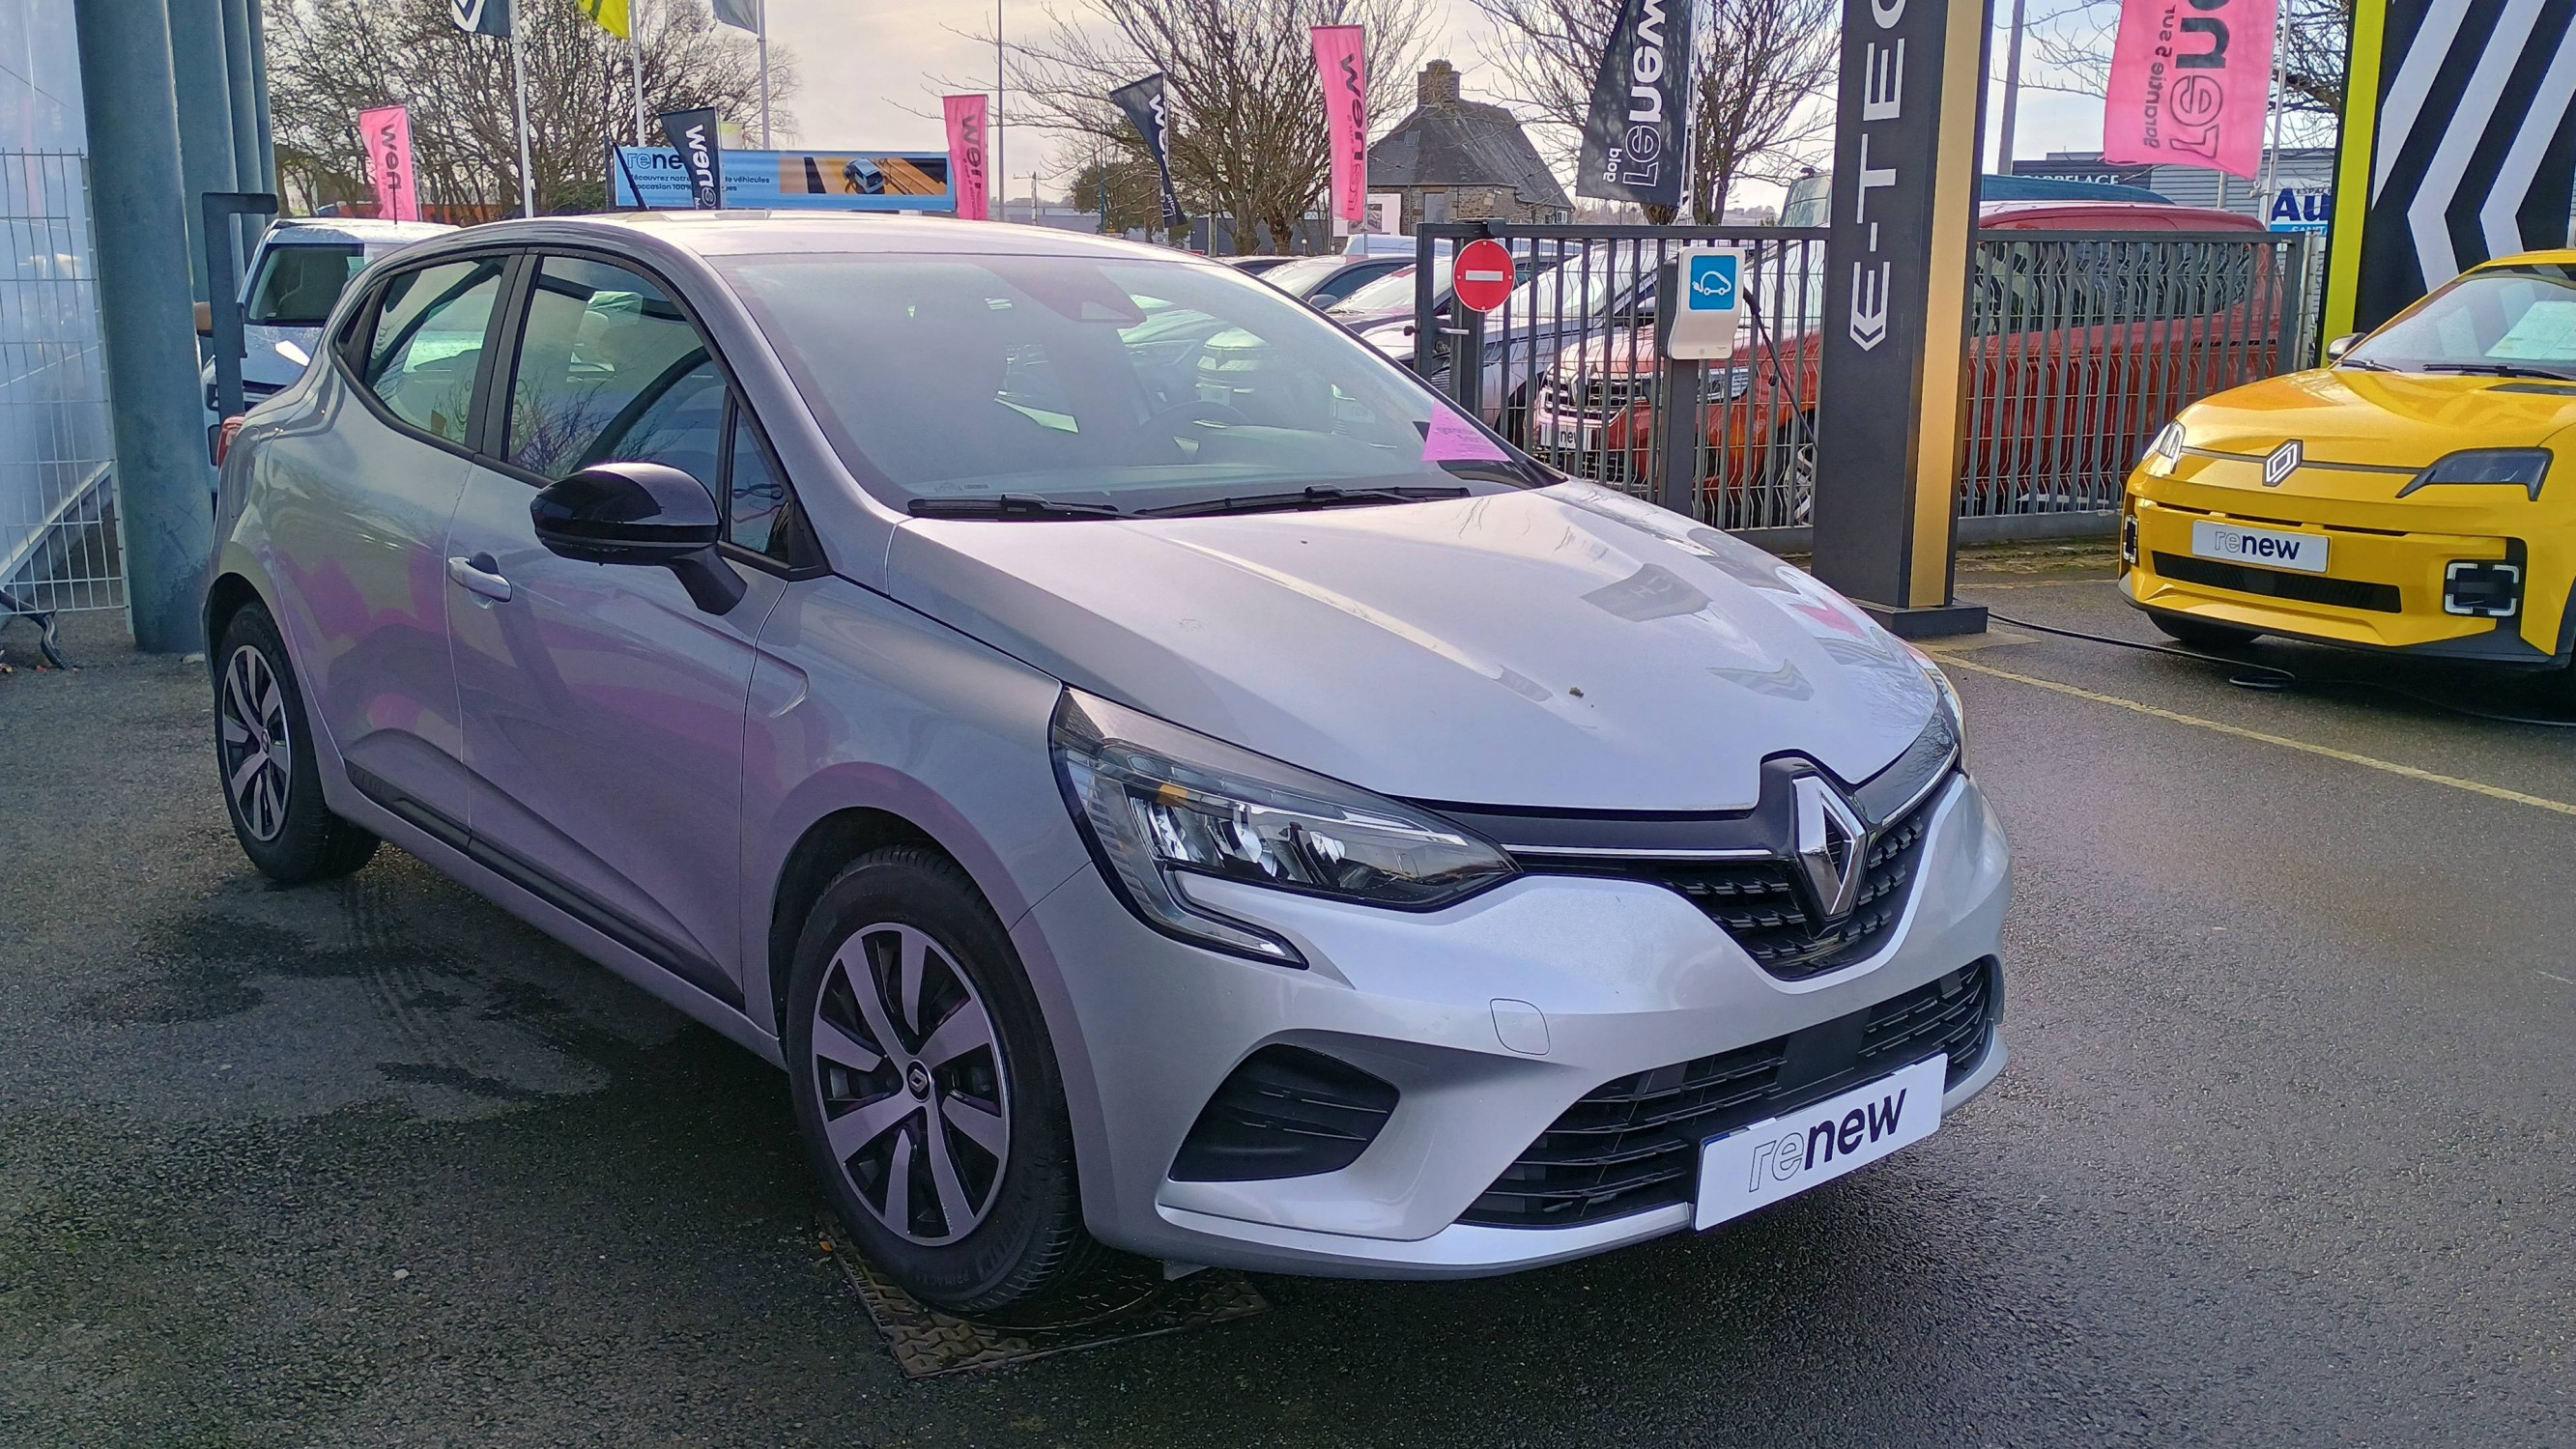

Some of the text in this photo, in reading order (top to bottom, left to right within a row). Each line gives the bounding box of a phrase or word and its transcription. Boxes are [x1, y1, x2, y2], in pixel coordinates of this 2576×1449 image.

[626, 153, 684, 170] rene
[2215, 530, 2301, 560] renew
[1749, 1088, 1907, 1193] renew
